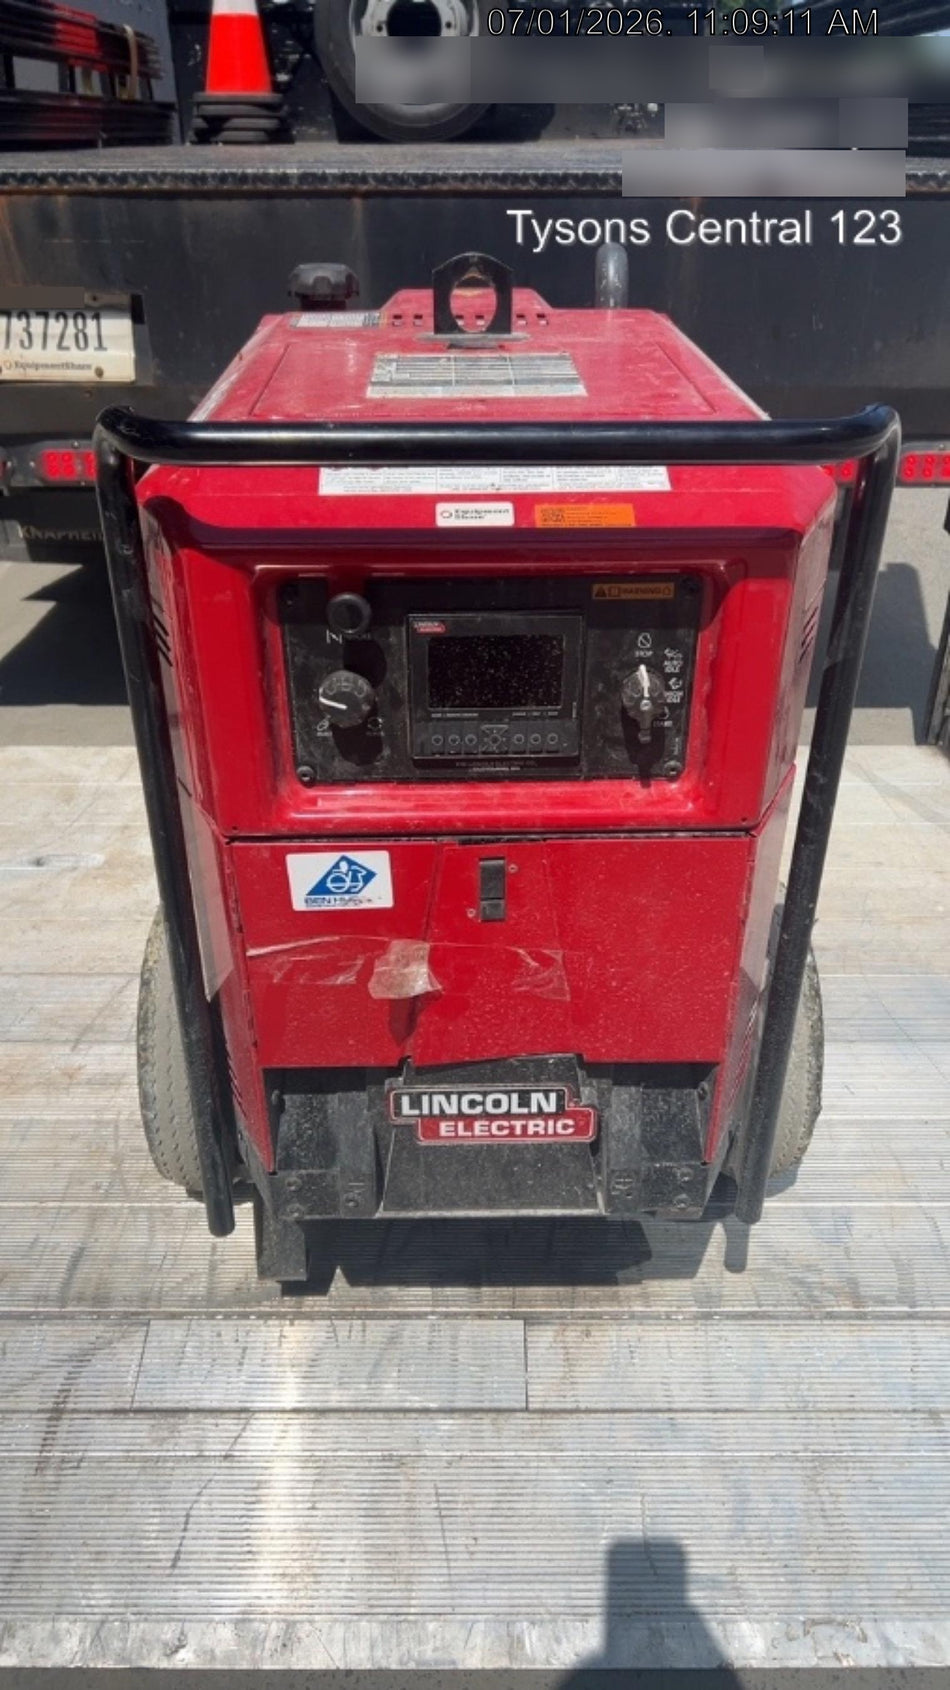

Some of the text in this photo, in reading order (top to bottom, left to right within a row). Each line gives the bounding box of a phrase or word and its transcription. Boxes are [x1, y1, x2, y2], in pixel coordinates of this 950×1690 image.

[0, 311, 108, 352] 737281
[400, 1092, 557, 1116] LINCOLN
[438, 1118, 576, 1137] ELECTRIC
